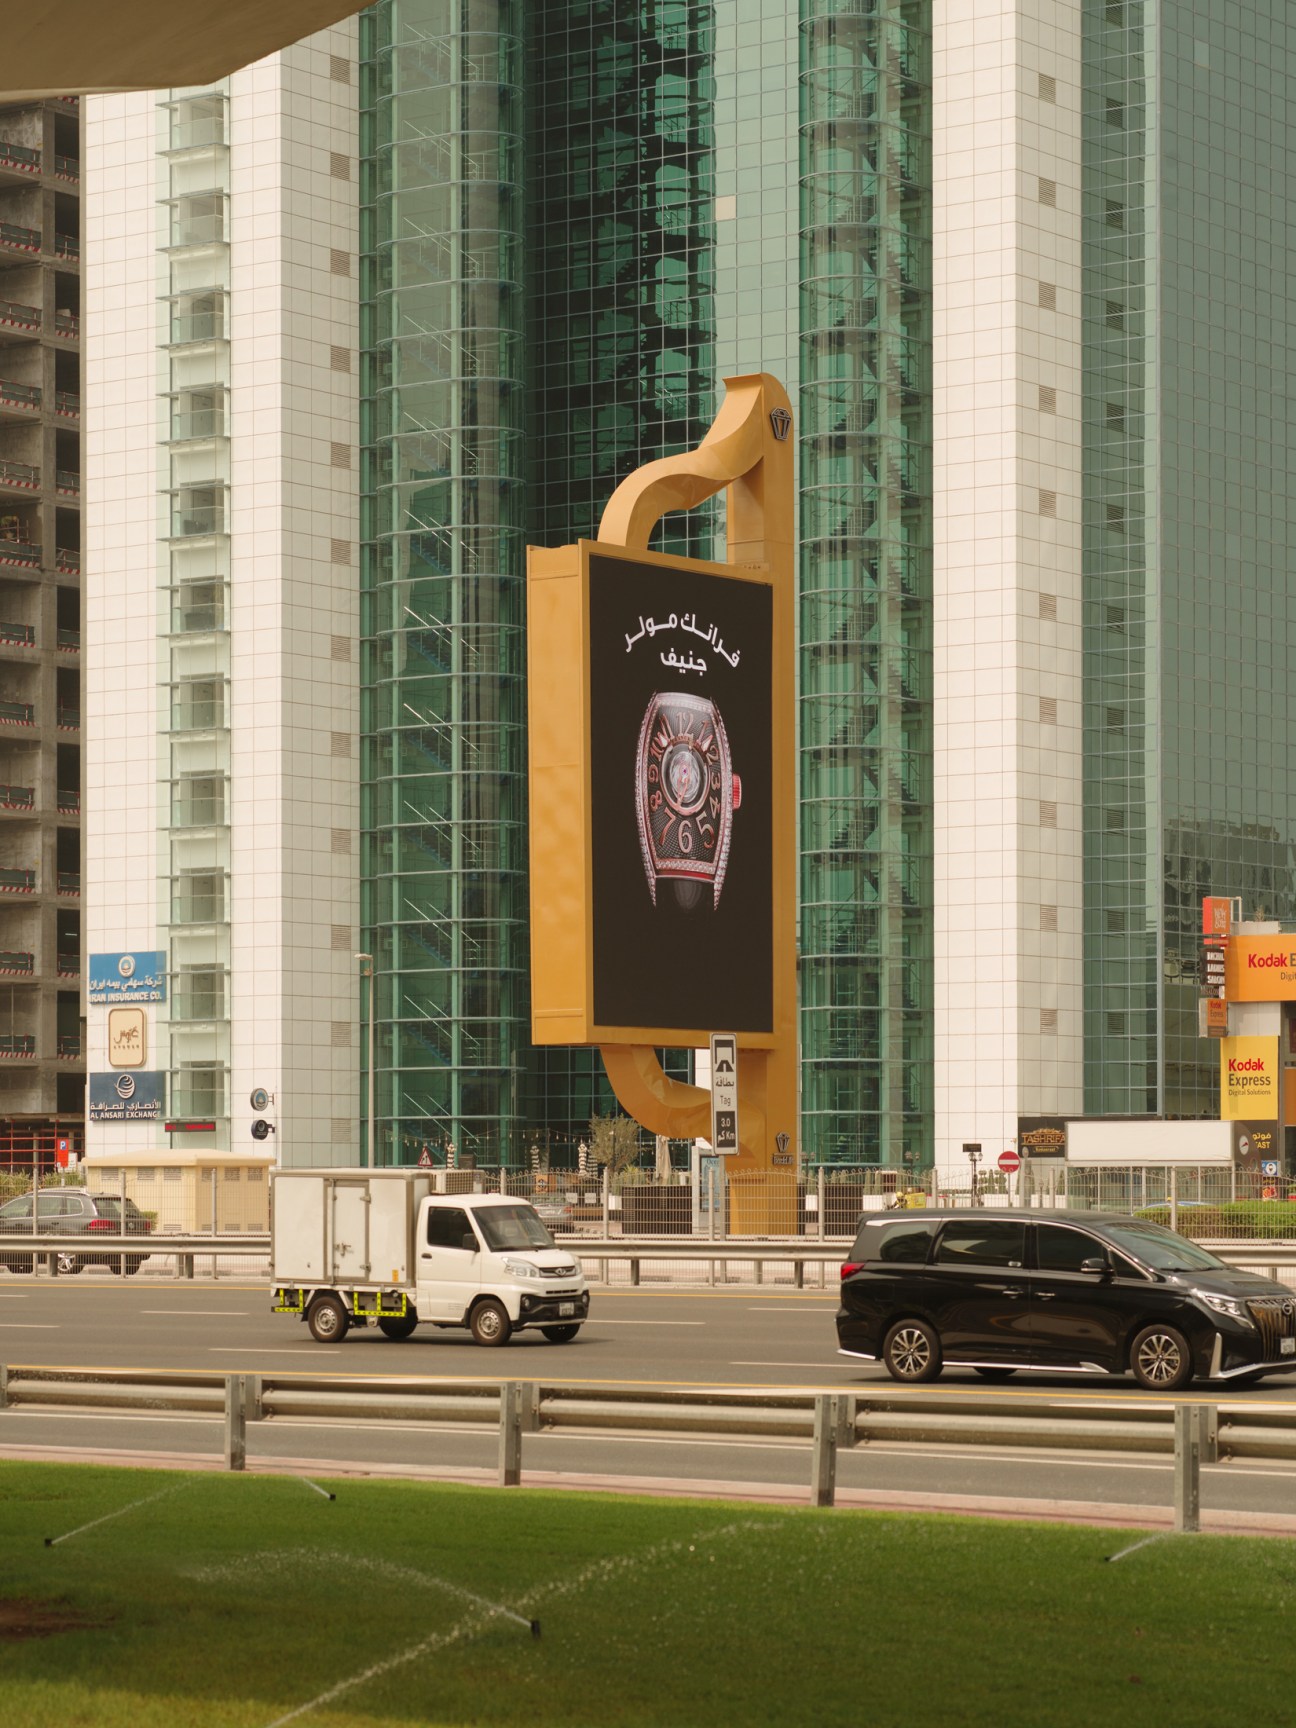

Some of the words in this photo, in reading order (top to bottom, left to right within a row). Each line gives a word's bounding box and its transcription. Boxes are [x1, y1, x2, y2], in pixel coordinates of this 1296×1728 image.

[624, 613, 679, 653] مولر
[680, 613, 741, 668] فرانك
[660, 647, 707, 676] جنيف
[659, 806, 676, 847] 7
[695, 810, 715, 849] 5
[678, 820, 693, 854] 6
[1248, 952, 1288, 969] Kodak
[89, 993, 106, 1003] IRAN
[107, 991, 150, 1003] INSURANCE
[1228, 1058, 1265, 1072] Kodak
[1228, 1073, 1271, 1089] Express
[720, 1095, 731, 1107] Tag
[1228, 1089, 1246, 1097] Digital
[100, 1111, 124, 1119] ANSARI
[126, 1110, 161, 1118] EXCHANGE
[720, 1117, 731, 1128] 3.0
[725, 1131, 736, 1140] Km
